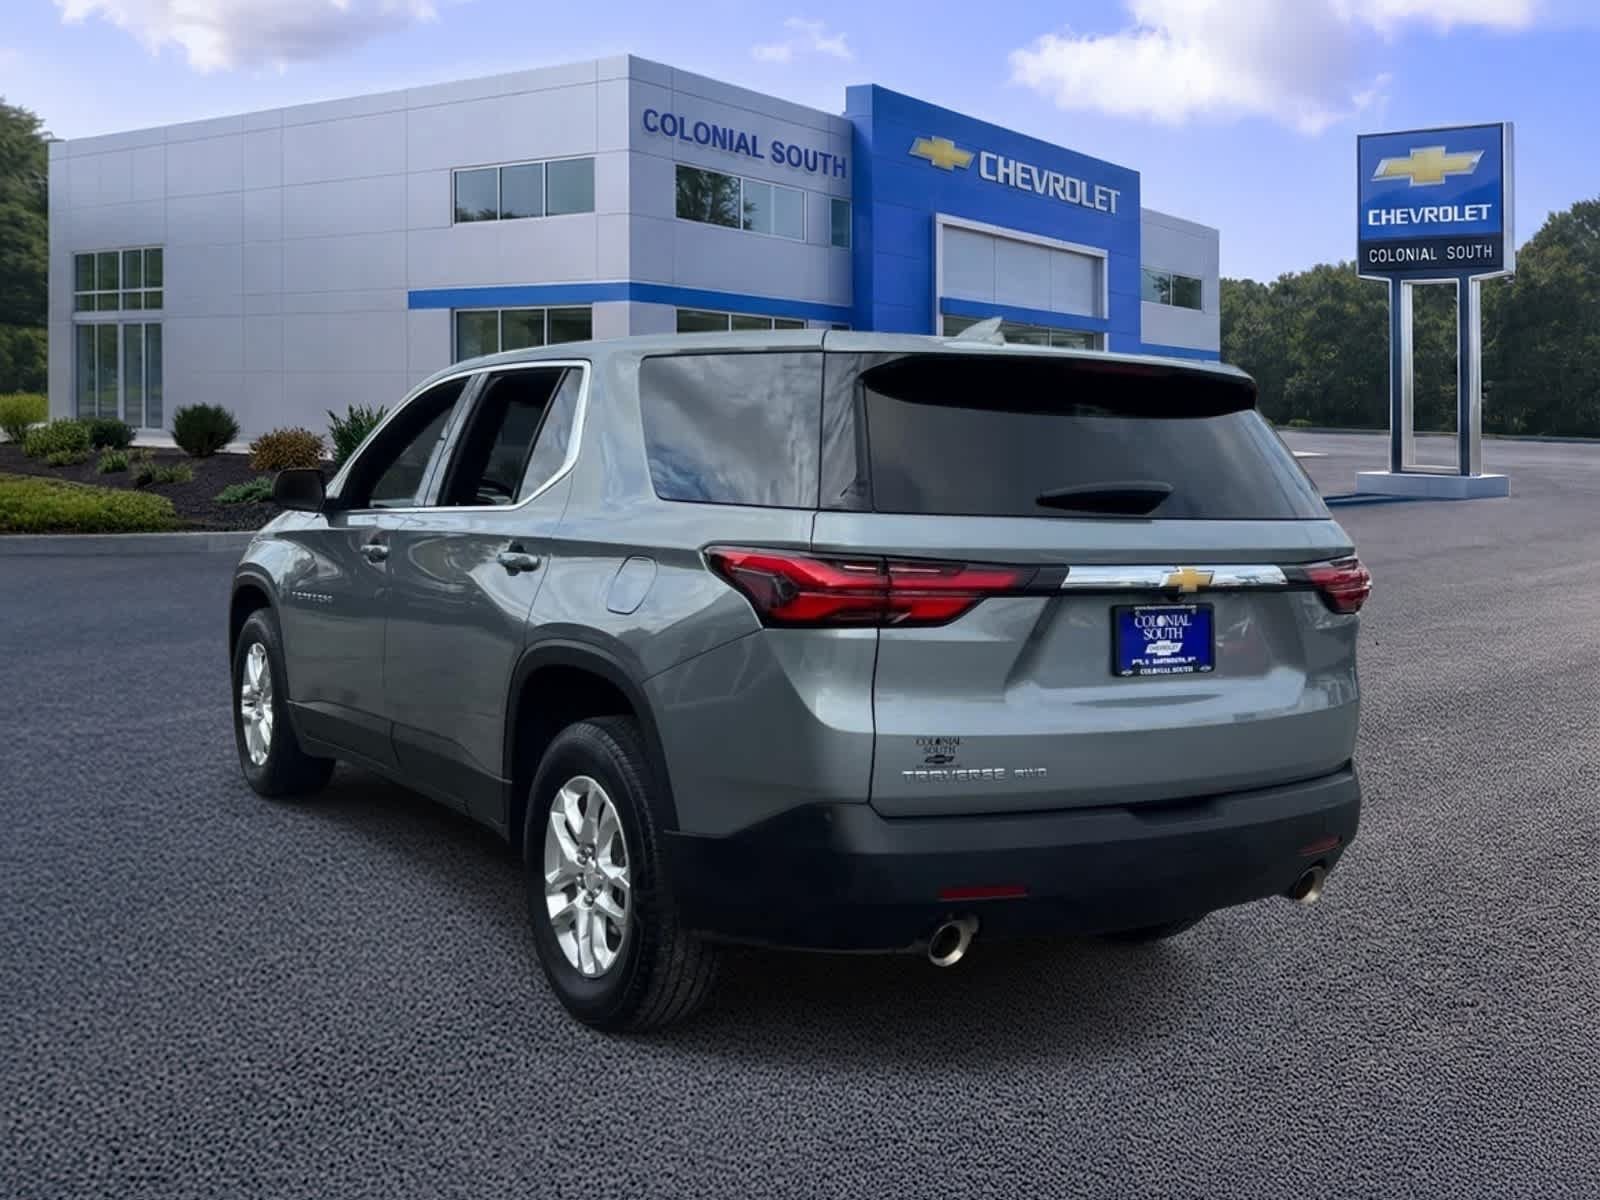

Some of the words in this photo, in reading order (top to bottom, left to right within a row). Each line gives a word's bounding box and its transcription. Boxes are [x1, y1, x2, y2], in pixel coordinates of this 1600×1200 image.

[643, 109, 764, 159] COLONIAL
[772, 142, 847, 179] SOUTH
[979, 151, 1121, 214] CHEVROLET
[1368, 204, 1492, 225] CHEVROLET
[1369, 248, 1437, 263] COLONIAL
[1447, 245, 1493, 259] SOUTH
[1134, 614, 1192, 628] COLONIAL
[1143, 627, 1183, 640] SOUTH
[902, 768, 1006, 783] TRAVERSE
